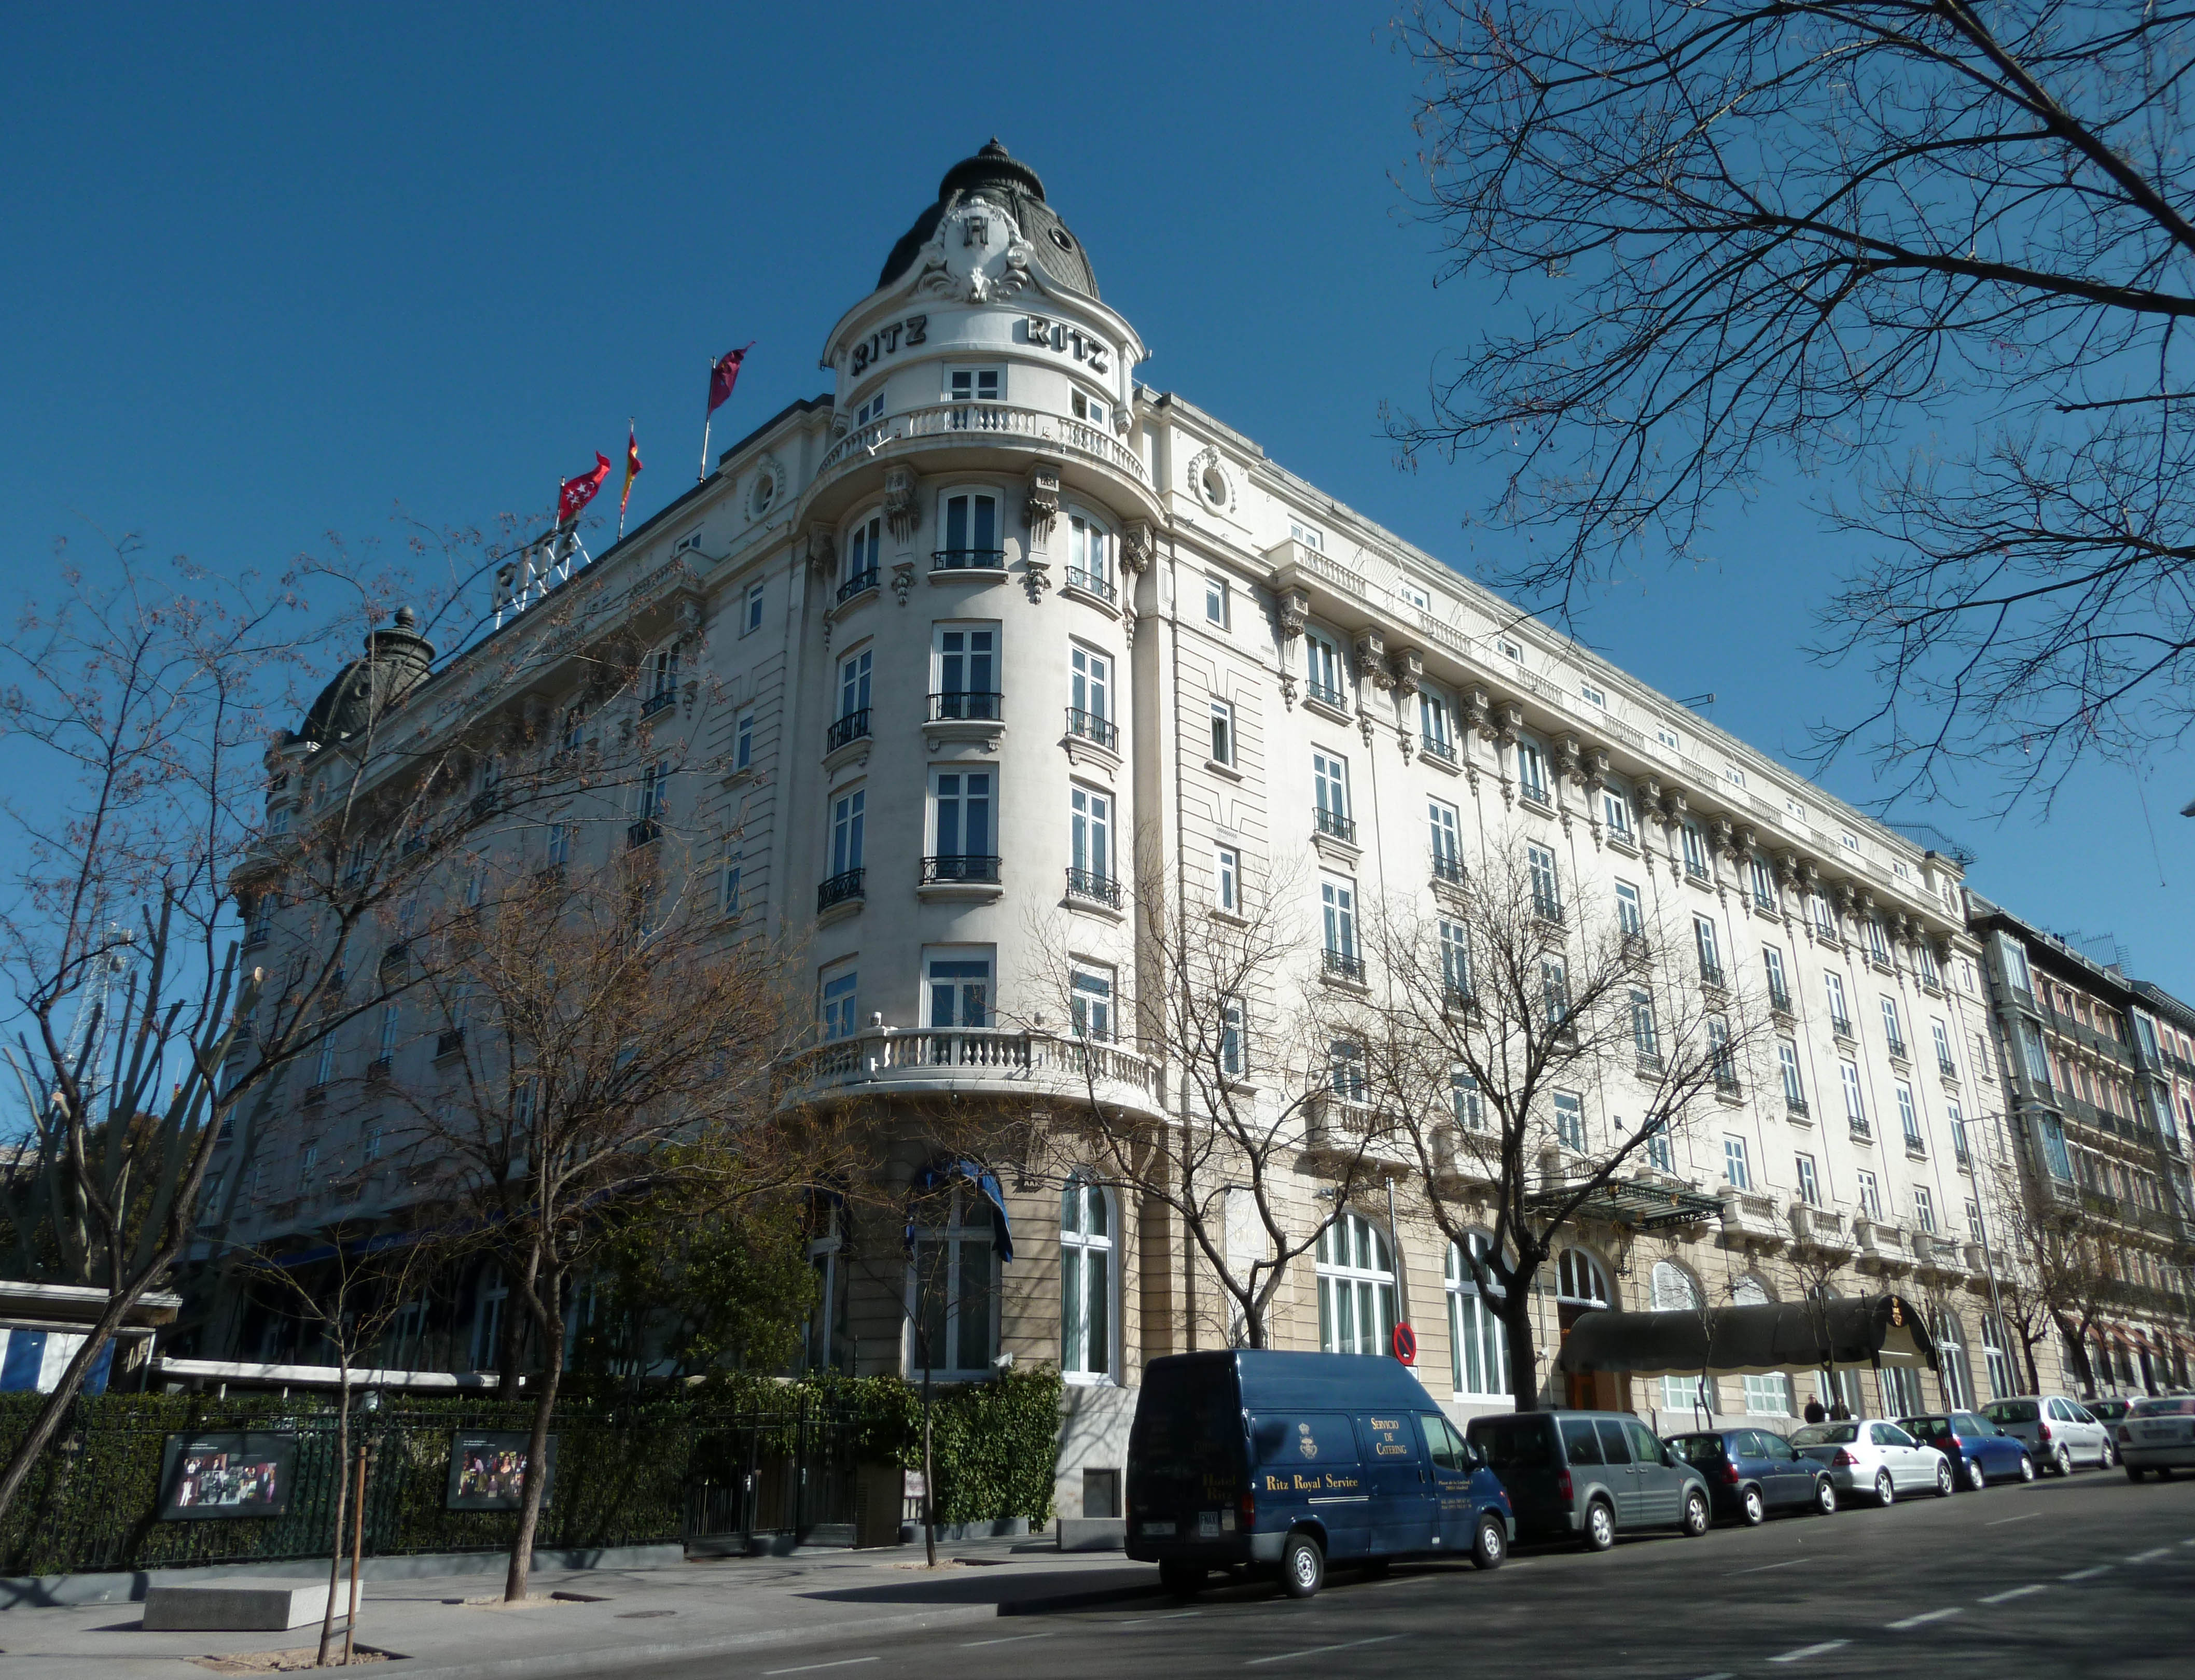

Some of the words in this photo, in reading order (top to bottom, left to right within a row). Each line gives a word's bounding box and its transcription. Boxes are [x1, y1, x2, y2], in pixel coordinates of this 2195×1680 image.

[851, 315, 927, 376] RITZ
[1027, 314, 1109, 374] RITZ
[1202, 1473, 1237, 1487] Hotel
[1266, 1475, 1289, 1491] Ritz
[1293, 1474, 1322, 1492] Royal
[1325, 1473, 1359, 1488] Service
[1206, 1486, 1233, 1501] Ritz
